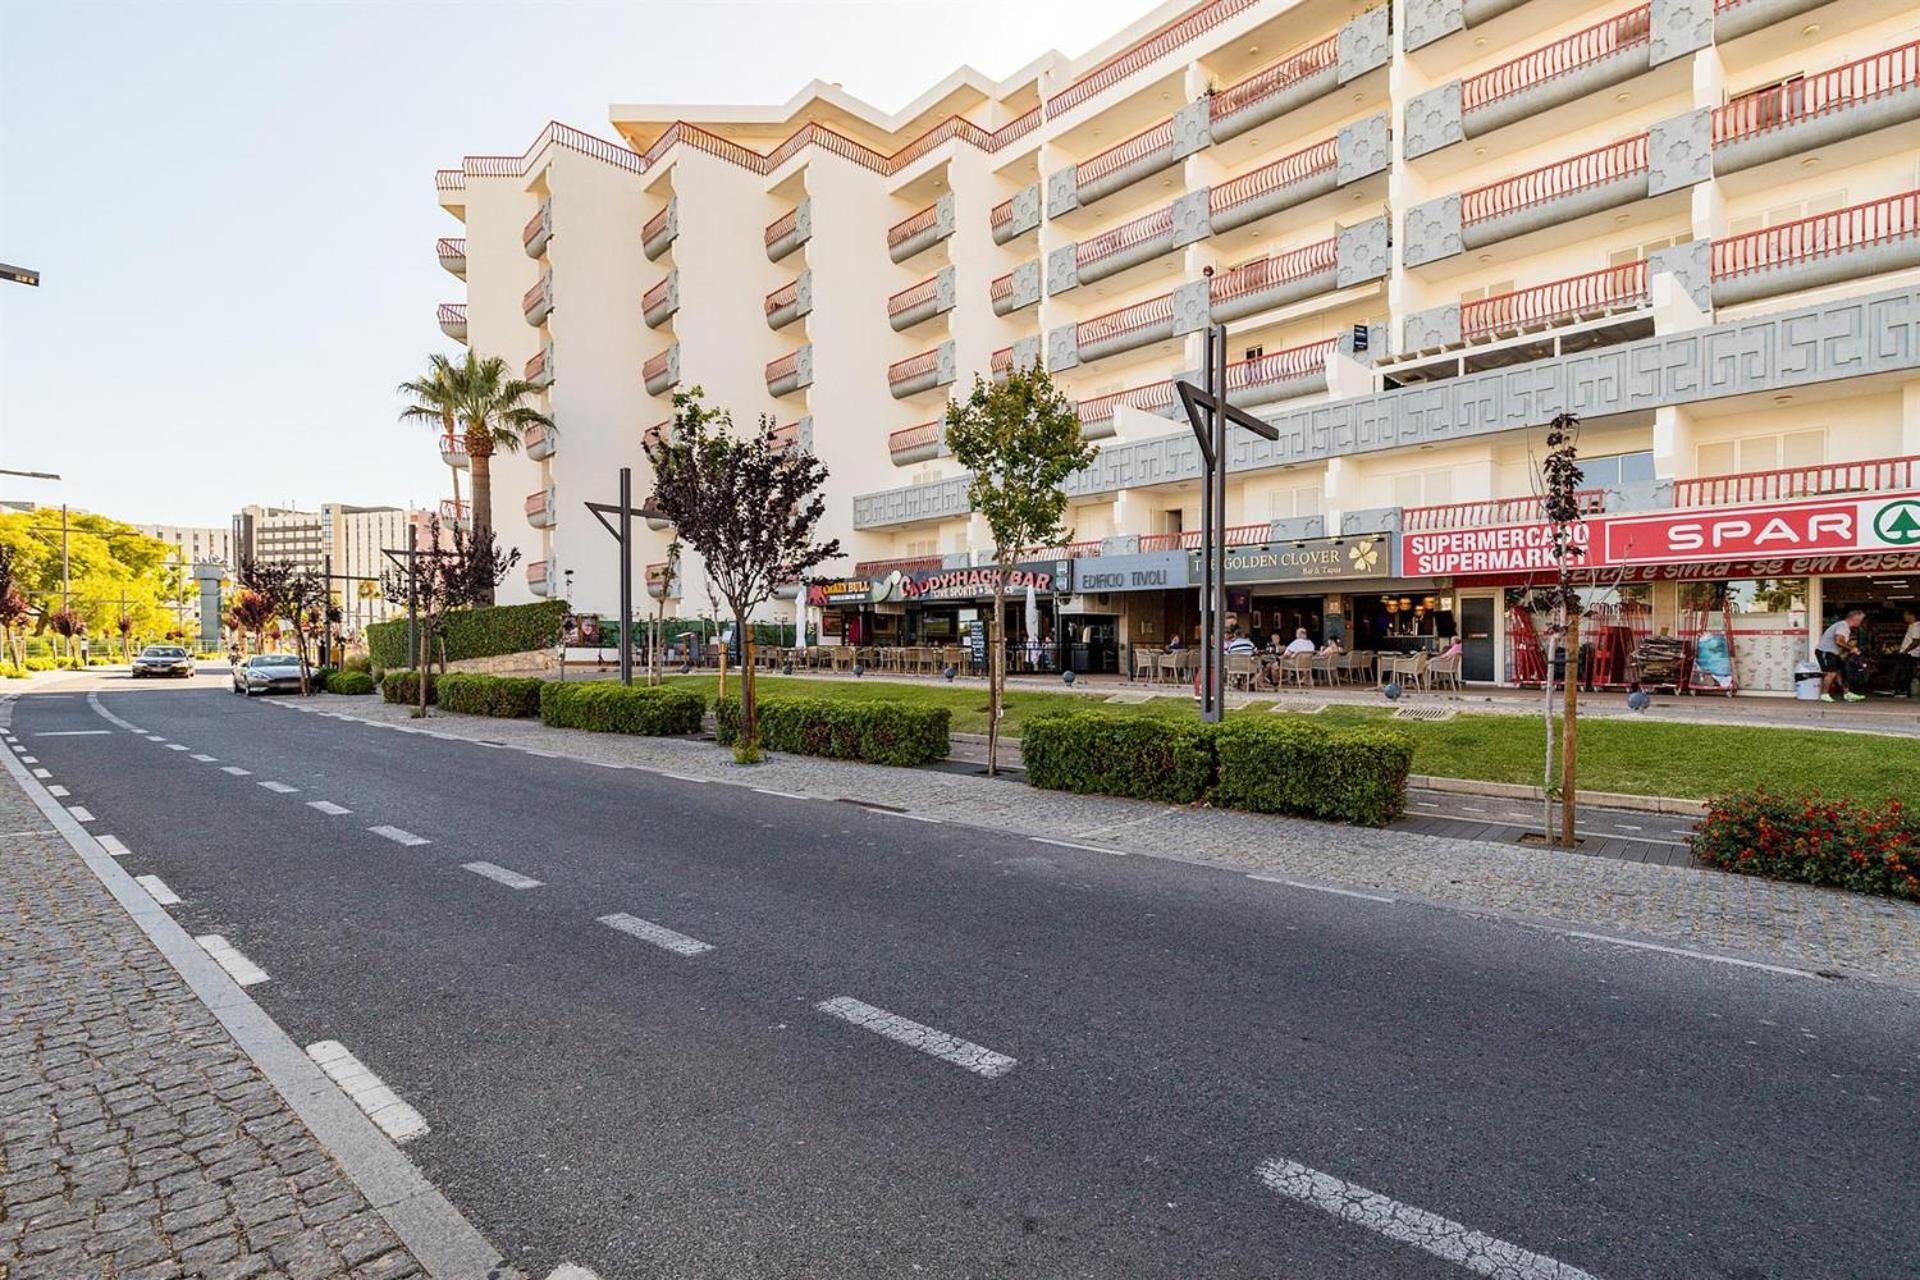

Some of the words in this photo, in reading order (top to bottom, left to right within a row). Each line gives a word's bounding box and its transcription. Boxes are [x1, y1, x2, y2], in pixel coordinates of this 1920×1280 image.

[1667, 513, 1852, 550] SPAR
[1224, 554, 1277, 570] GOLDEN
[1281, 550, 1340, 566] CLOVER
[1792, 556, 1839, 573] em
[1009, 570, 1052, 590] BAR
[1082, 573, 1124, 589] EDIFICIO
[1131, 569, 1168, 586] TIVOLI
